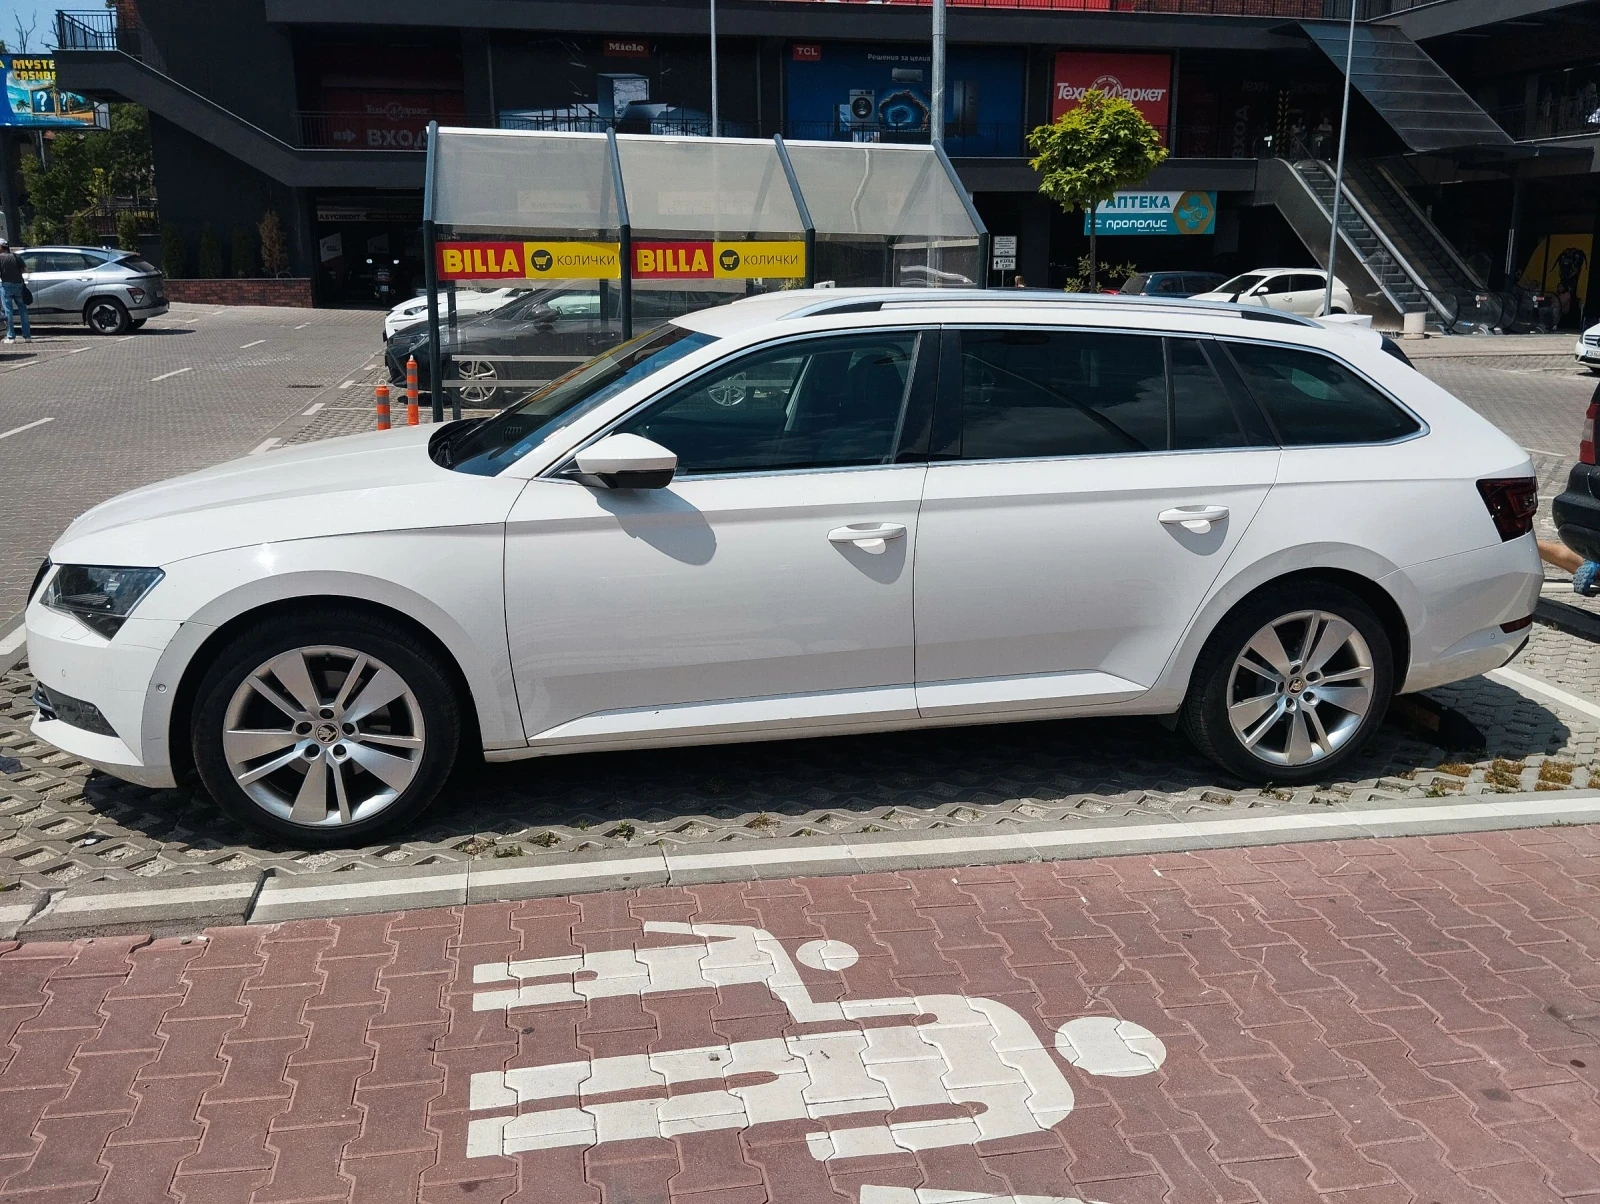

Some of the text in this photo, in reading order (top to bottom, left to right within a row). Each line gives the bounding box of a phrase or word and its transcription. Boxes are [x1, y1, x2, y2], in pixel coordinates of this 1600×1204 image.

[608, 42, 645, 52] Miele
[796, 47, 818, 56] TCL
[867, 53, 899, 61] Решения
[1105, 195, 1171, 209] АПТЕКА
[442, 248, 520, 274] BILLA
[556, 253, 616, 266] КОЛИЧКИ
[636, 248, 708, 273] BILLA
[742, 253, 799, 266] КОЛИЧКИ
